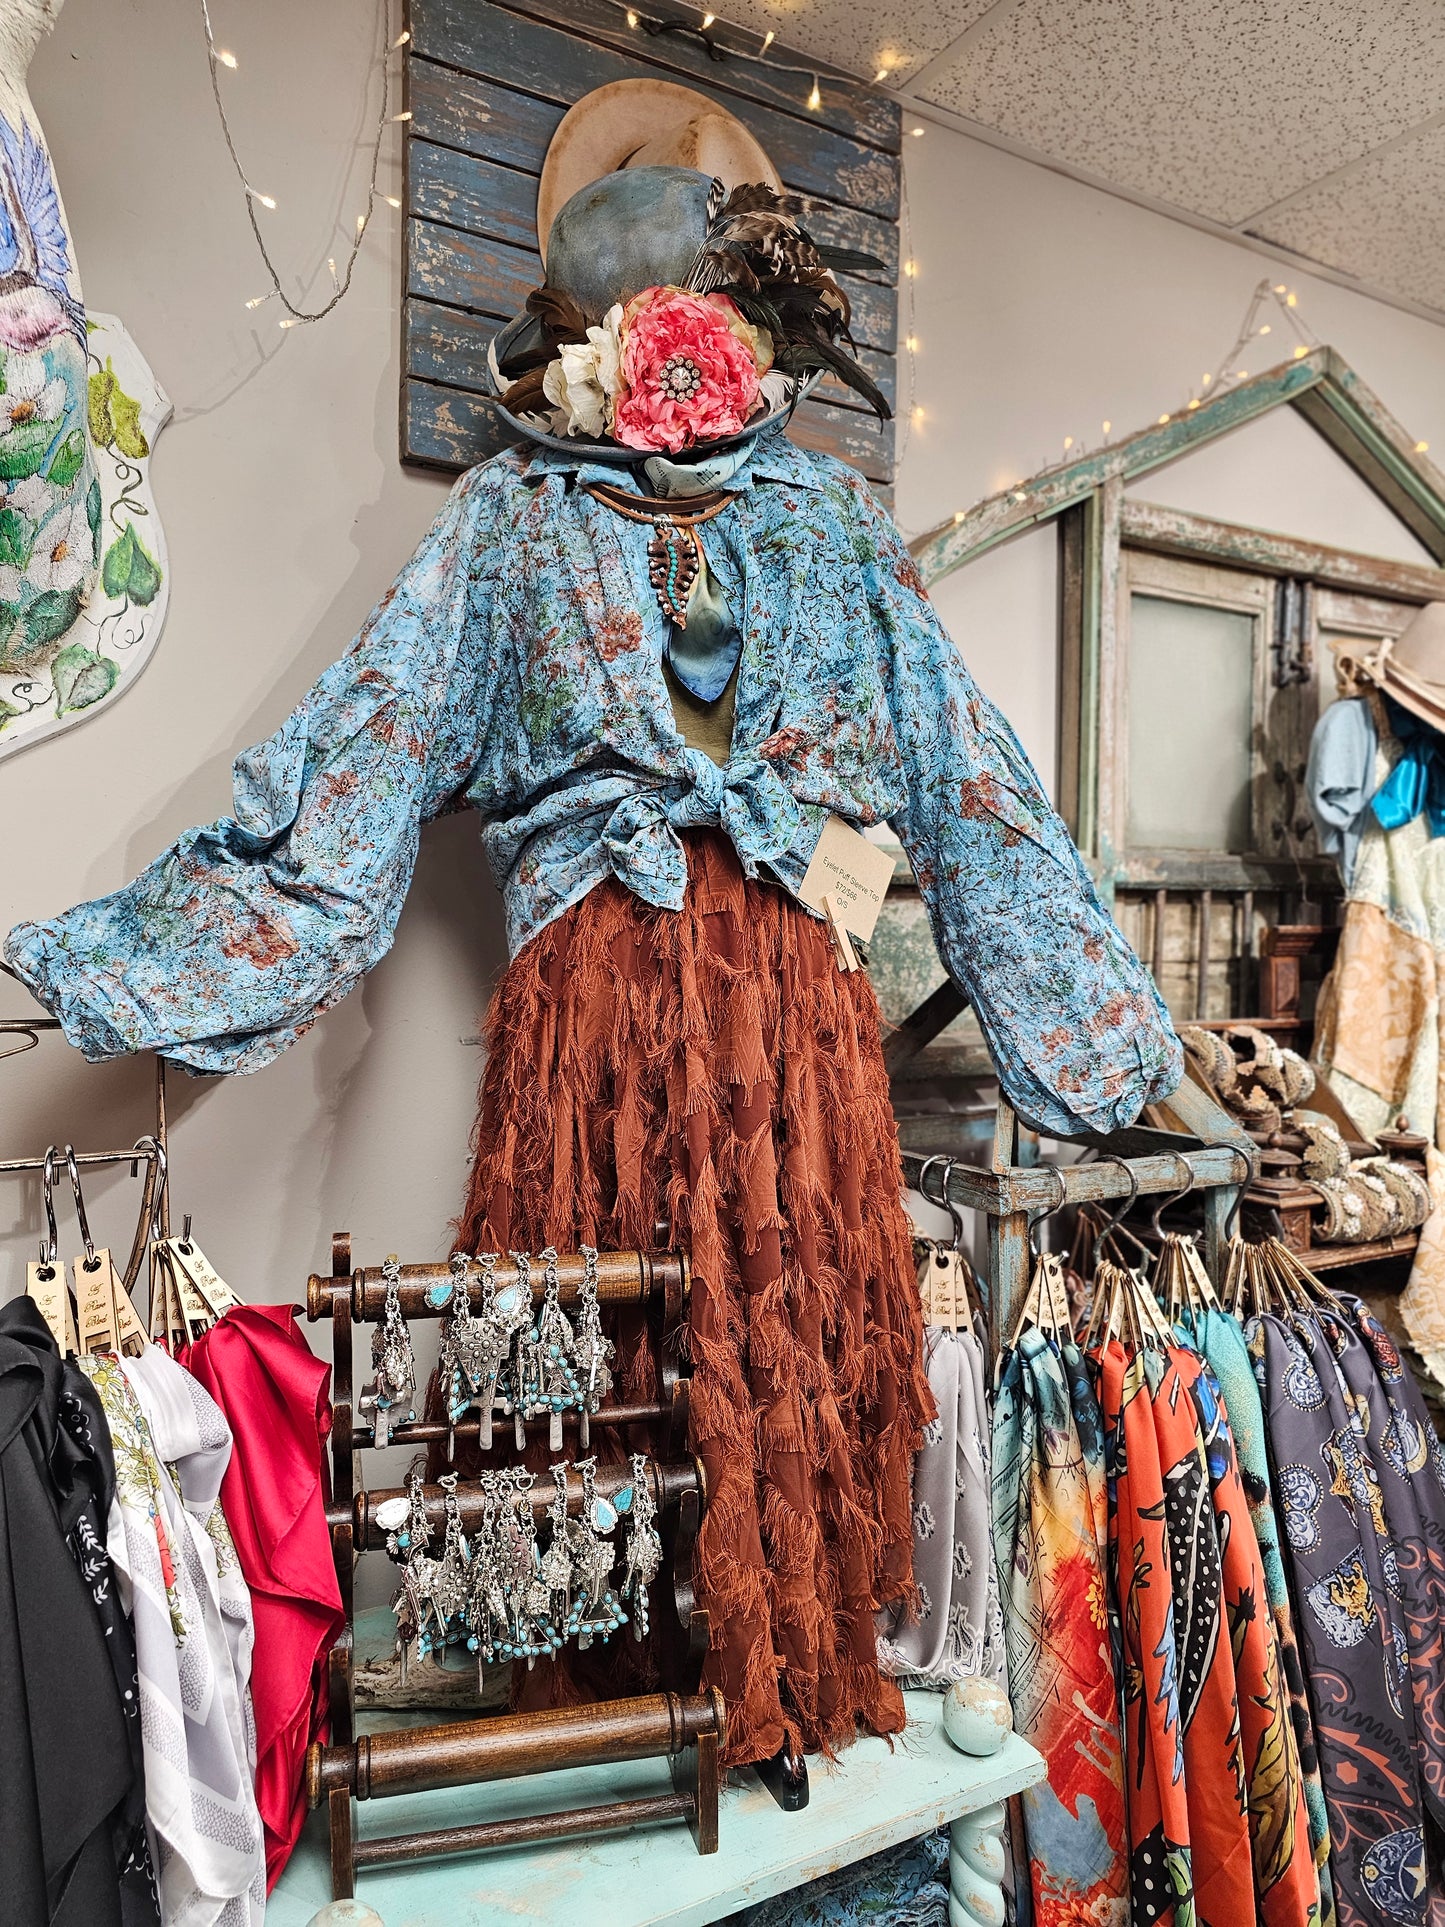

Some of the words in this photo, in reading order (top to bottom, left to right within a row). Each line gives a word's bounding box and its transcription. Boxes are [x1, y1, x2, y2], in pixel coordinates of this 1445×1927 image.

[823, 856, 839, 873] Eyelet
[839, 868, 851, 881] Puff
[850, 877, 869, 895] Sleeve
[869, 889, 880, 902] Top
[836, 897, 849, 909] O/S
